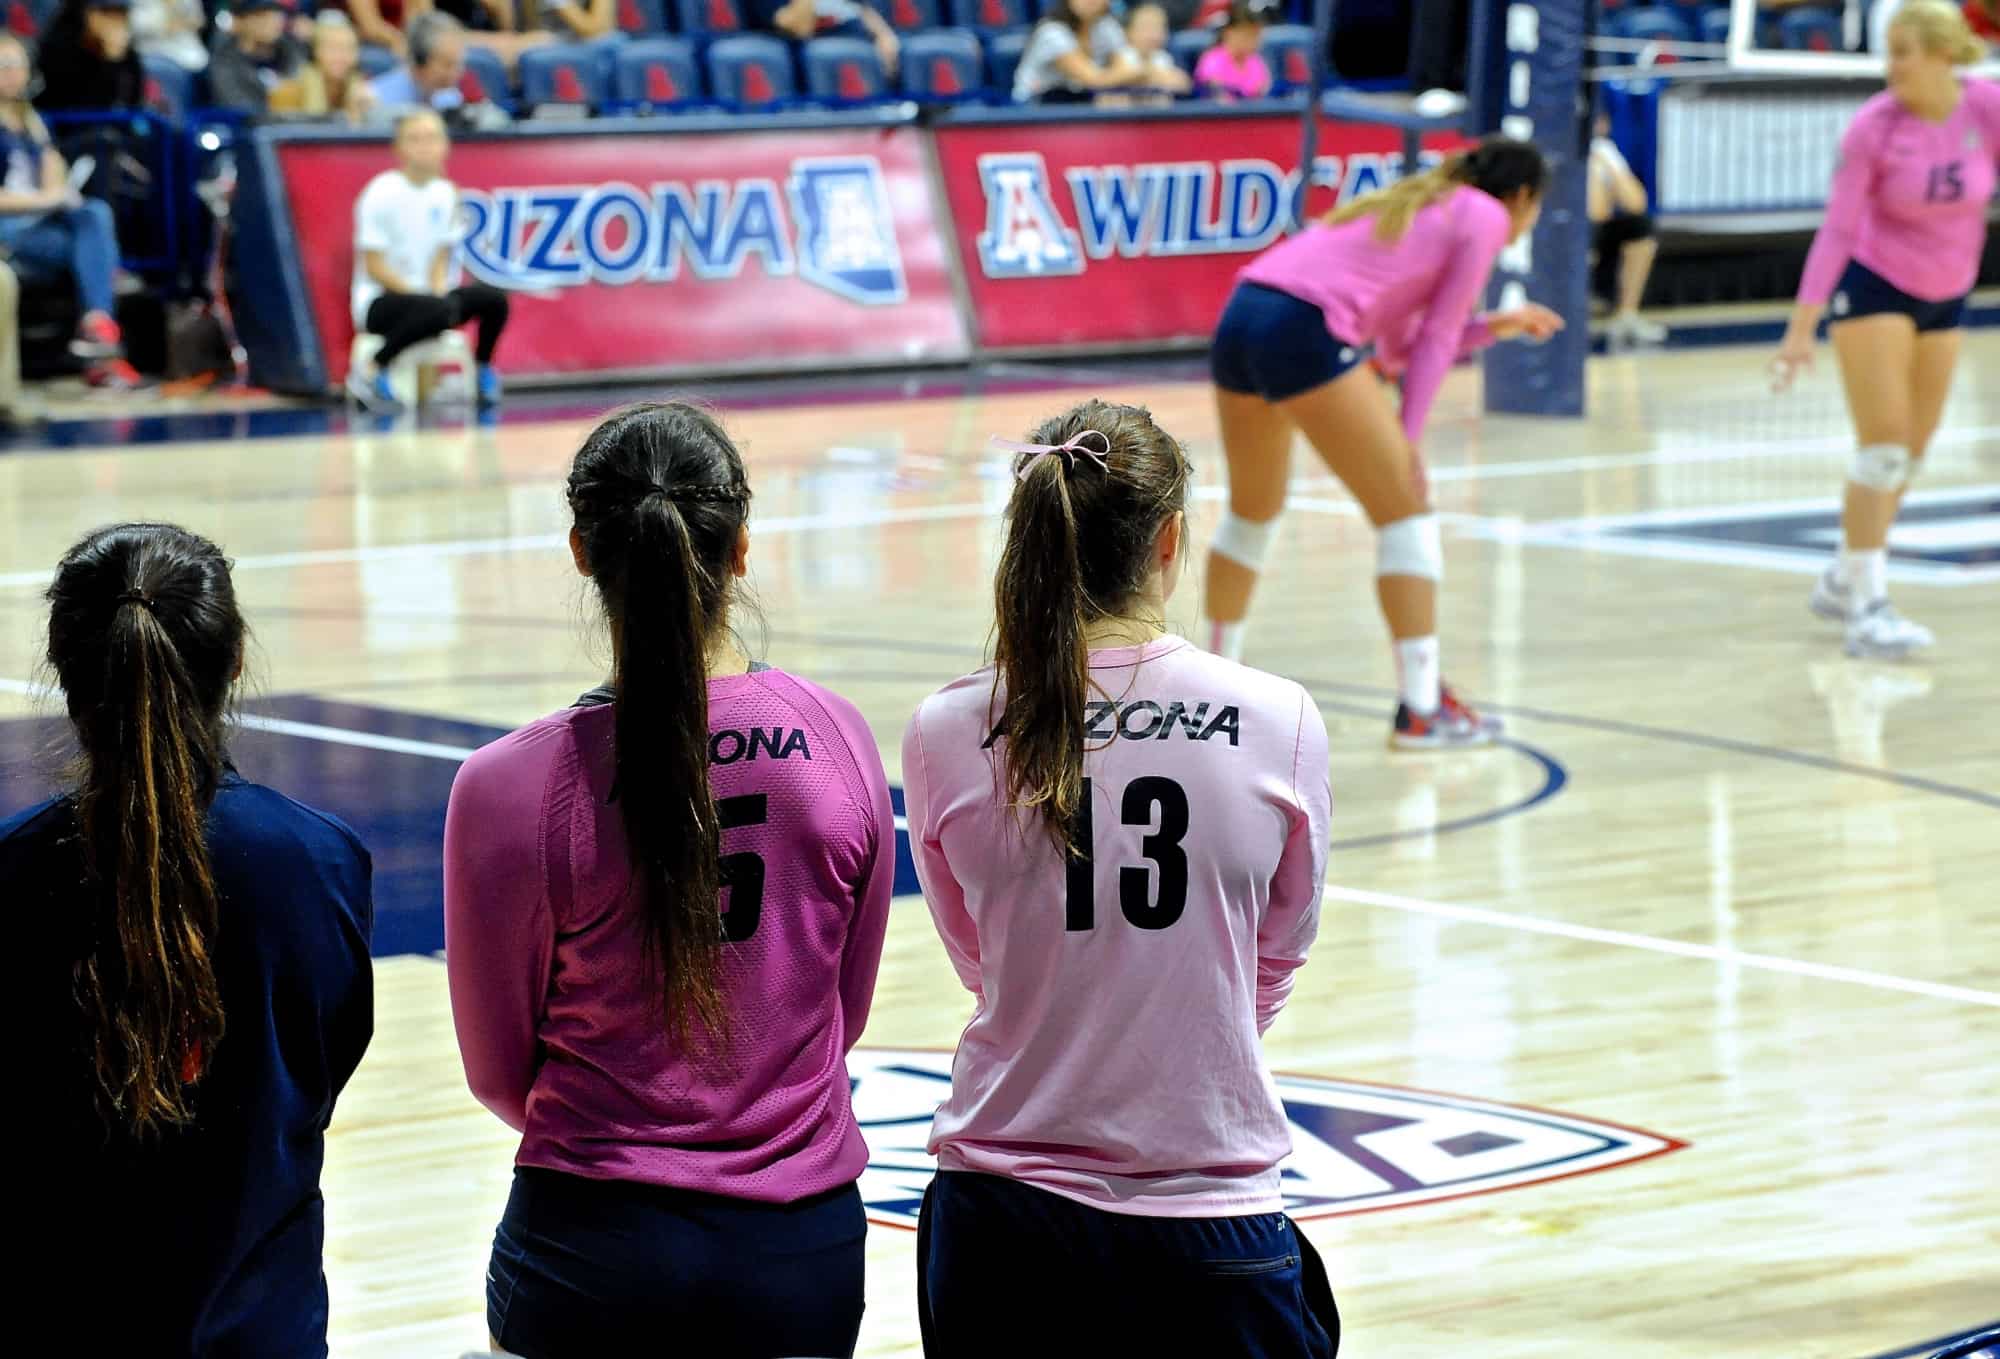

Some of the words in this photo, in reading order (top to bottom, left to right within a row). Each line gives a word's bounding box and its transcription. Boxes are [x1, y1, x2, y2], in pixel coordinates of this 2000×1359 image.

[449, 179, 794, 291] RIZONA
[977, 152, 1086, 278] A
[1064, 150, 1445, 259] WILDCA
[1926, 160, 1965, 204] 15
[980, 699, 1239, 749] ZONA
[1065, 775, 1189, 931] 13
